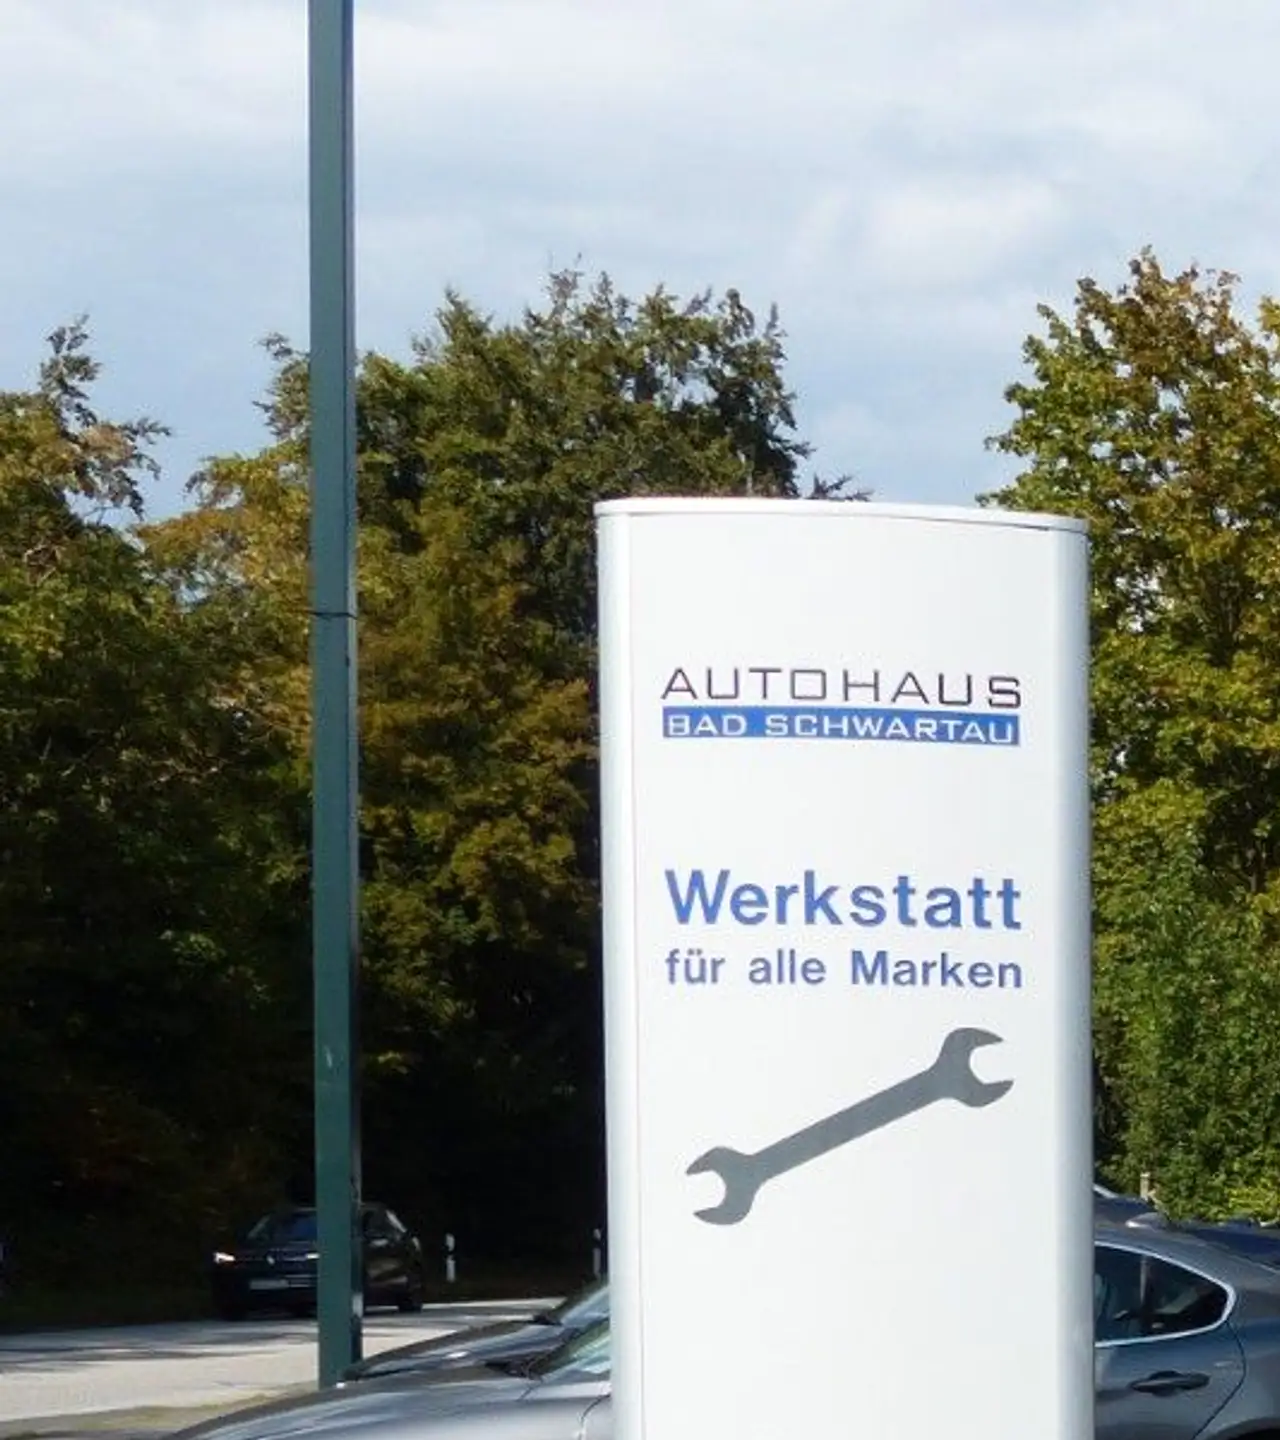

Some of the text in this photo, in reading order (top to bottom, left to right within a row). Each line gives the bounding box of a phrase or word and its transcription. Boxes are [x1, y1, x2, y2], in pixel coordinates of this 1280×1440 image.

[661, 667, 1022, 709] AUTOHAUS
[668, 713, 1014, 744] BAD SCHWARTAU
[664, 869, 1022, 930] Werkstatt
[665, 948, 1023, 989] für alle Marken
